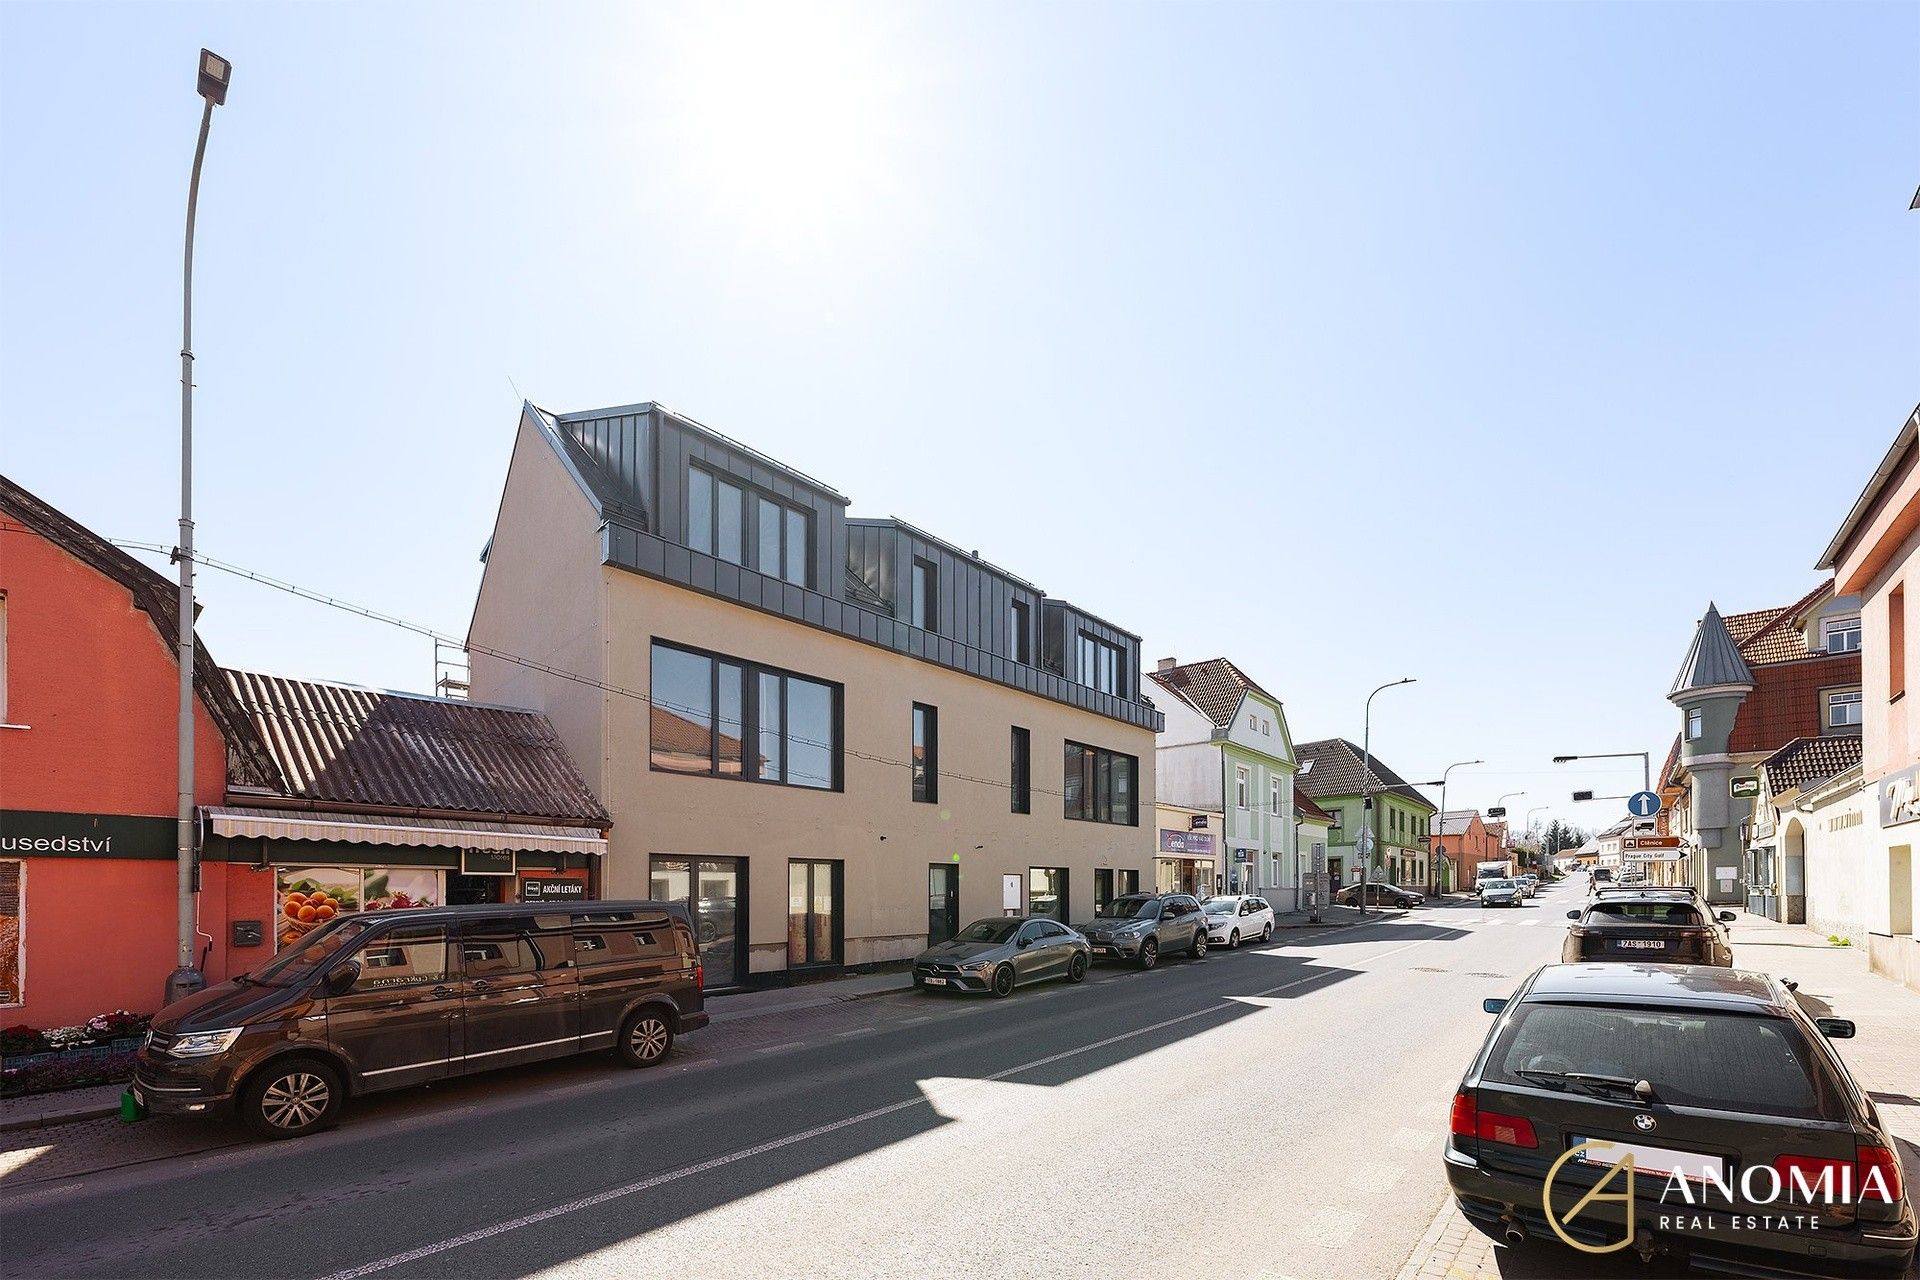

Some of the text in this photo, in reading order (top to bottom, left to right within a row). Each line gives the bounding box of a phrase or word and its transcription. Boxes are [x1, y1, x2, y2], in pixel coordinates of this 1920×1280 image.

[1, 835, 112, 852] usedství
[542, 883, 561, 894] AKČNÍ
[561, 883, 583, 894] LETÁKY
[1643, 940, 1661, 948] 1910
